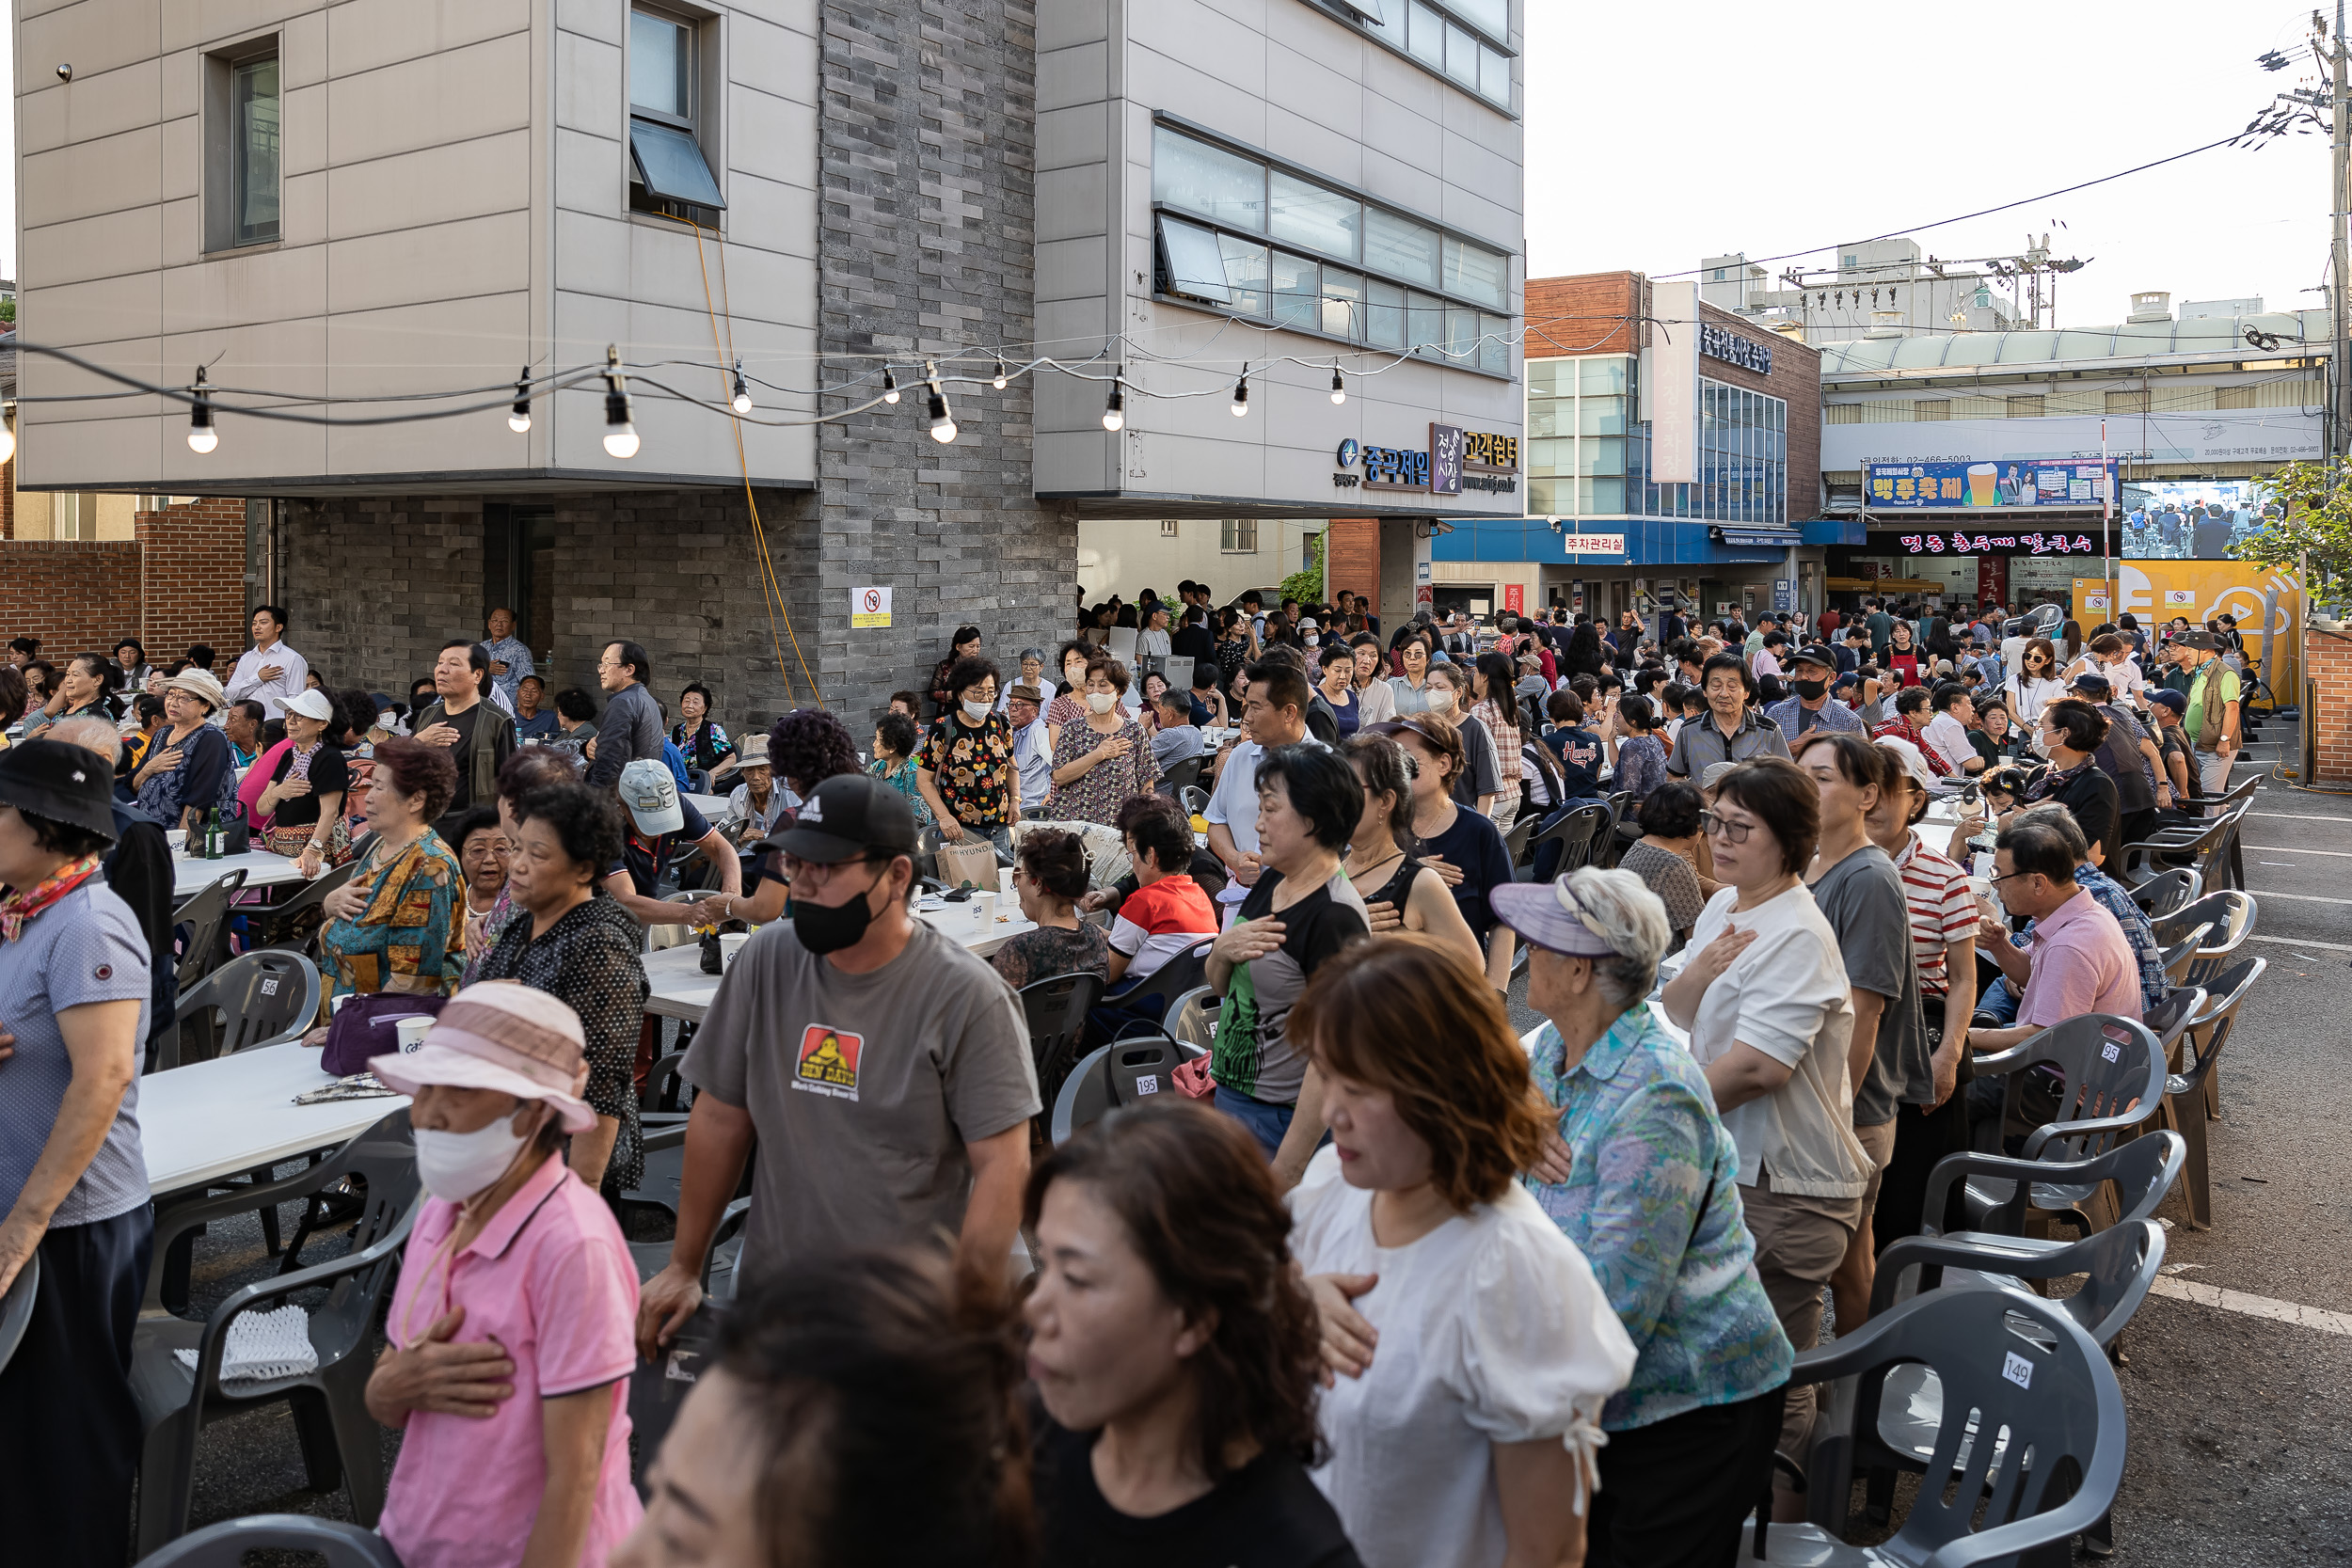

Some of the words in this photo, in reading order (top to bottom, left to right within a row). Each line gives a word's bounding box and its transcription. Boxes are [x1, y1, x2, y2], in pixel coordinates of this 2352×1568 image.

[1704, 324, 1750, 366] 중곡전통시장
[1752, 343, 1772, 373] 주차장
[1465, 432, 1518, 467] 고객쉼터
[1362, 446, 1429, 485] 중곡제일
[1333, 473, 1359, 487] 광진구
[1873, 477, 1962, 500] 맥주축제
[1567, 537, 1624, 552] 주차관리실
[1900, 535, 1945, 552] 명동
[1951, 533, 2015, 552] 홍두깨
[2020, 533, 2092, 554] 칼국수
[868, 596, 877, 606] 19
[263, 981, 277, 994] 56
[2104, 1045, 2118, 1060] 95
[801, 1063, 824, 1080] BEN
[1138, 1078, 1155, 1093] 195
[2007, 1359, 2028, 1383] 149
